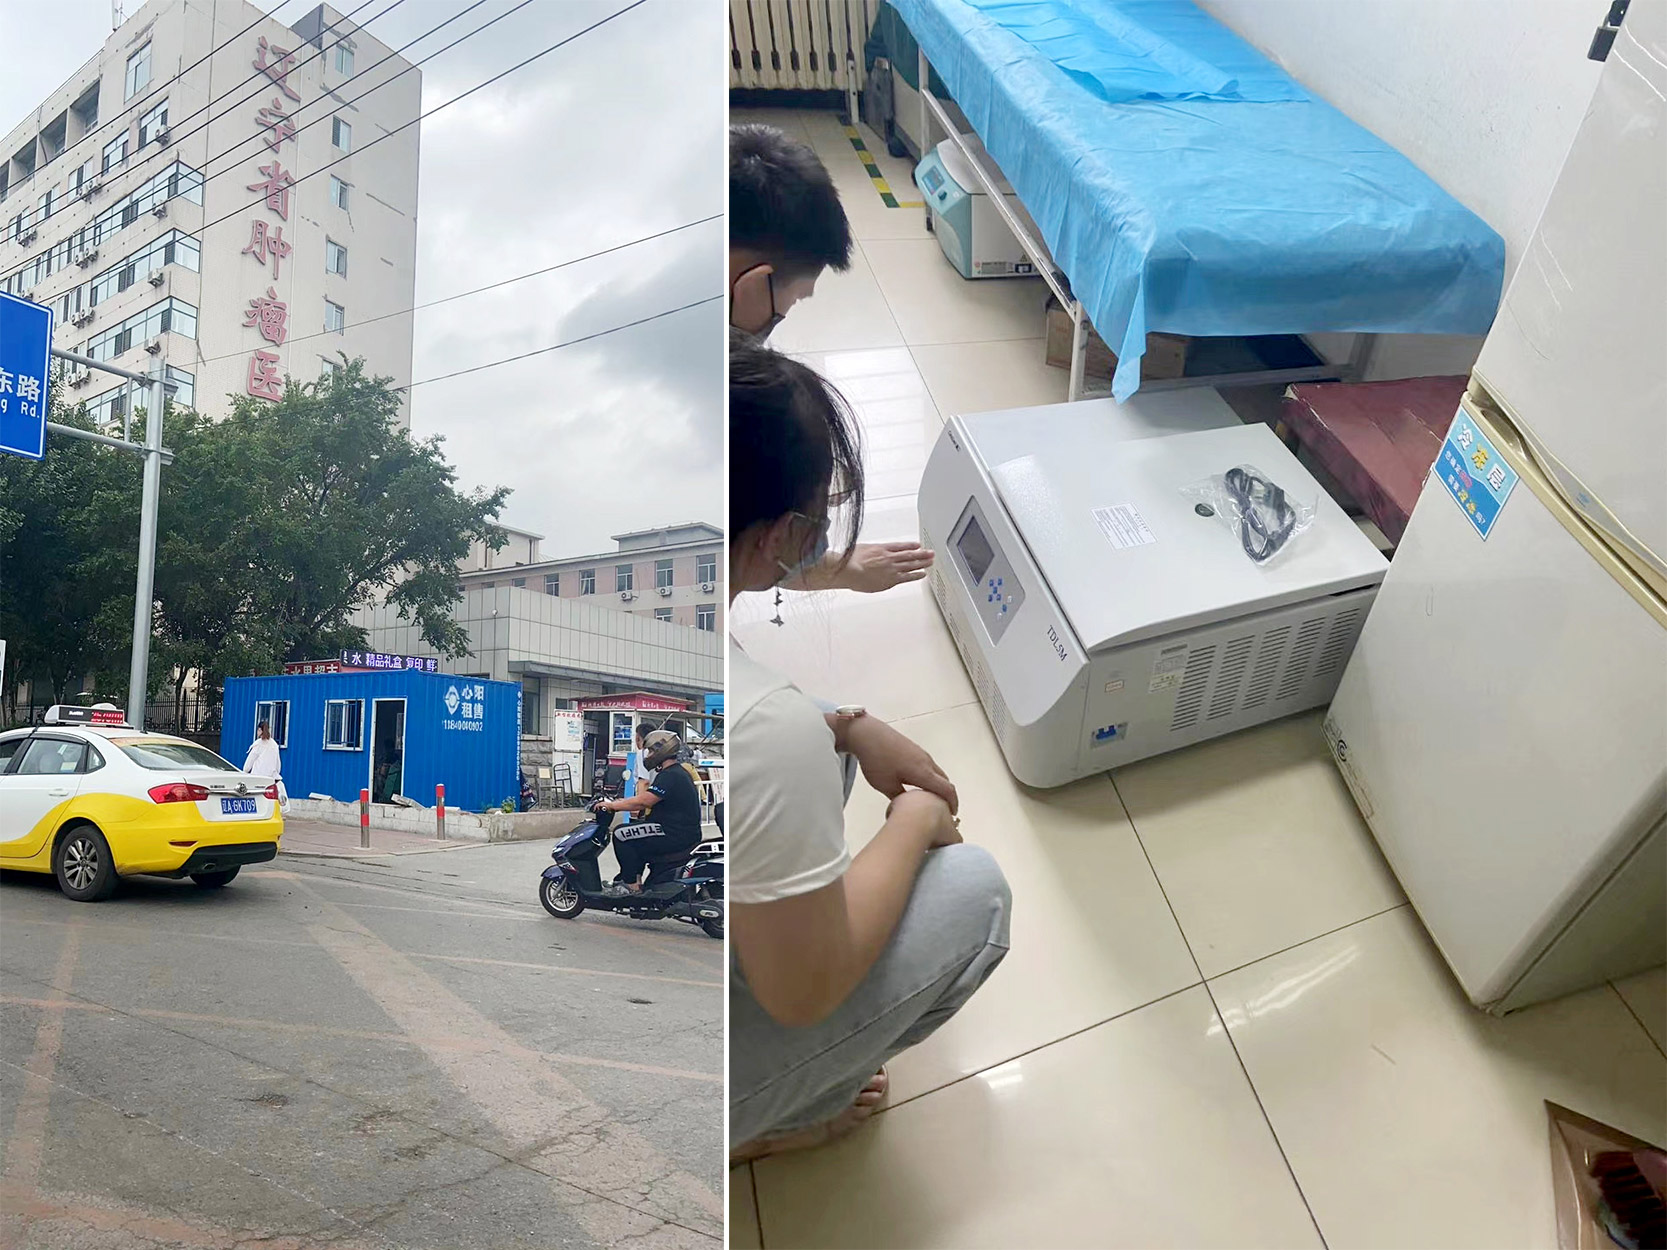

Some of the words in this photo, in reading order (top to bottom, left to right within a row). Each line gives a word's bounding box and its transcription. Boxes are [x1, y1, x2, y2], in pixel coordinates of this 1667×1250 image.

[242, 35, 301, 402] 辽宁省肿瘤医
[20, 401, 40, 419] Rd.
[1456, 423, 1507, 492] 冷冻层
[365, 652, 403, 669] 精品礼盒
[461, 684, 485, 701] 心阳
[461, 702, 484, 720] 租售
